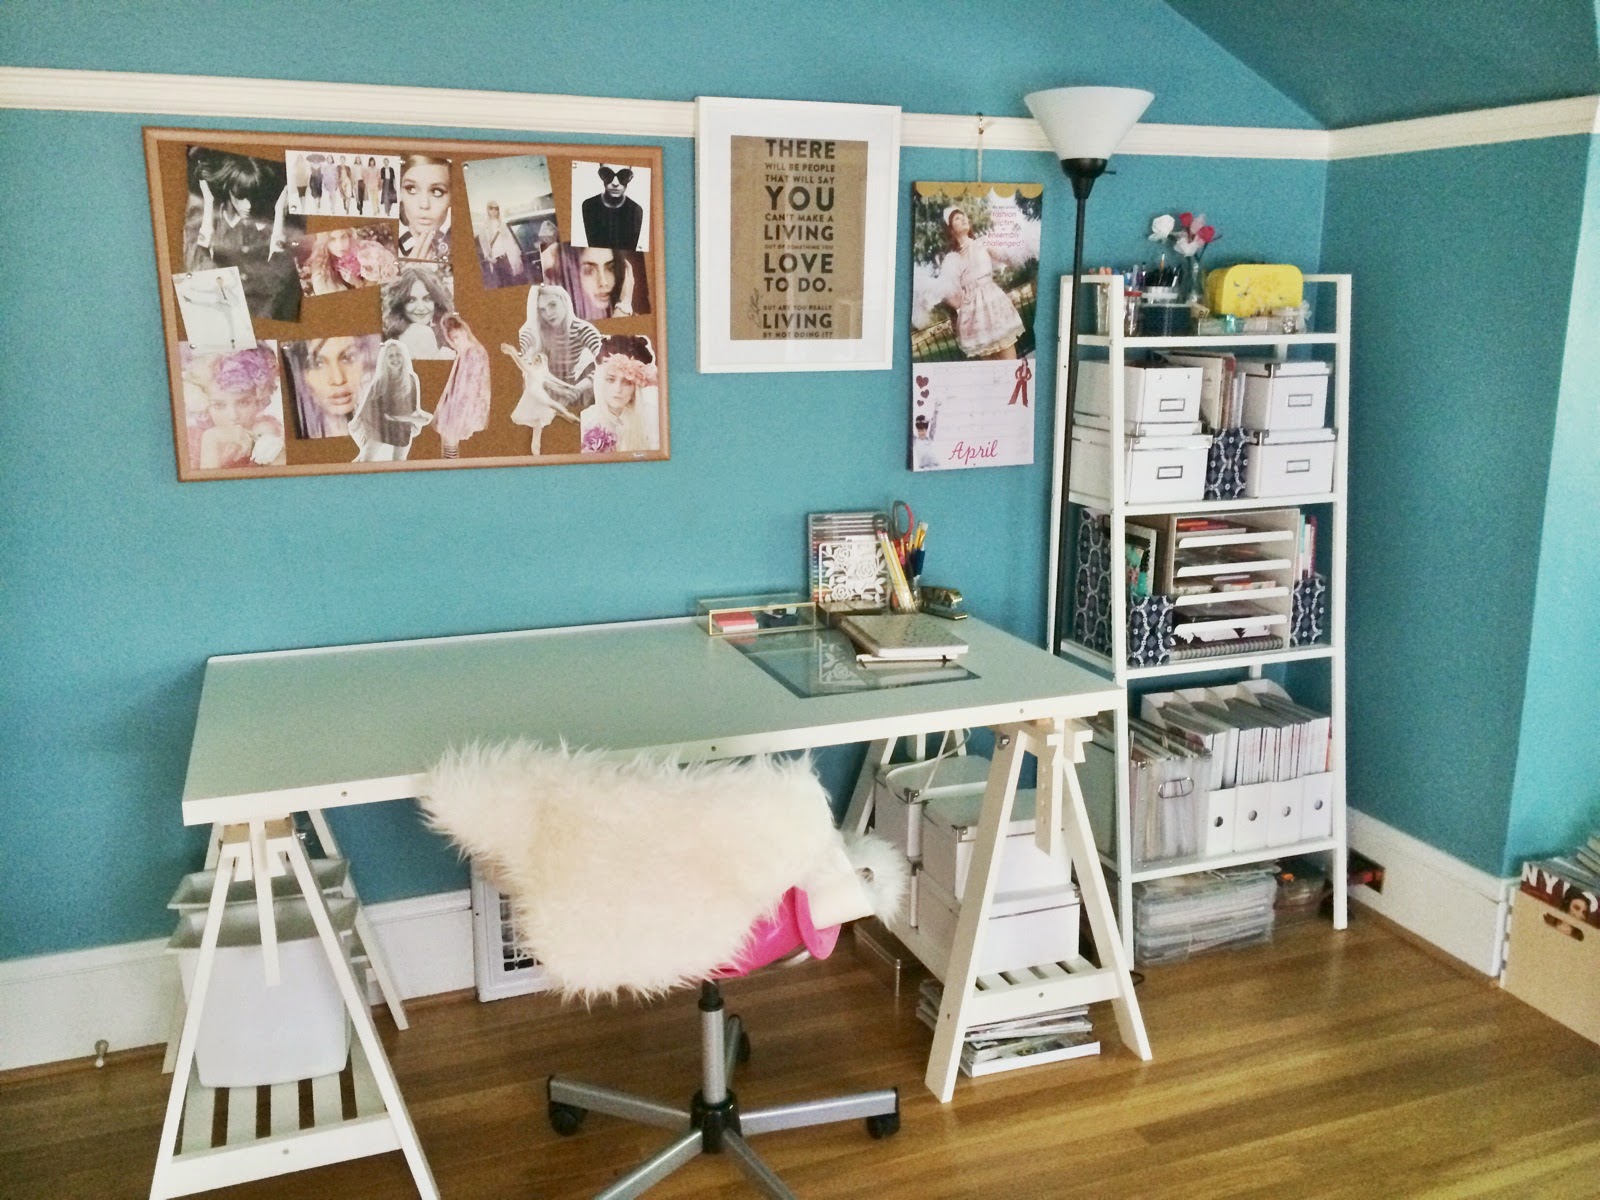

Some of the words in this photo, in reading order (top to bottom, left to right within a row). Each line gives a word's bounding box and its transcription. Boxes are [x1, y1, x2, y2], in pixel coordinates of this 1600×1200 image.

[765, 139, 836, 159] THERE
[765, 163, 786, 171] WILL
[789, 163, 800, 171] BE
[802, 164, 836, 173] PEOPLE
[765, 174, 789, 183] THAT
[793, 175, 814, 183] WILL
[818, 176, 835, 184] SAY
[765, 185, 835, 212] YOU
[765, 213, 794, 221] CAN'T
[797, 214, 825, 222] MAKE
[827, 214, 834, 222] A
[764, 224, 834, 241] LIVING
[764, 252, 834, 274] LOVE
[763, 277, 790, 292] TO
[798, 277, 833, 293] DO.
[763, 312, 832, 329] LIVING
[948, 439, 998, 466] April
